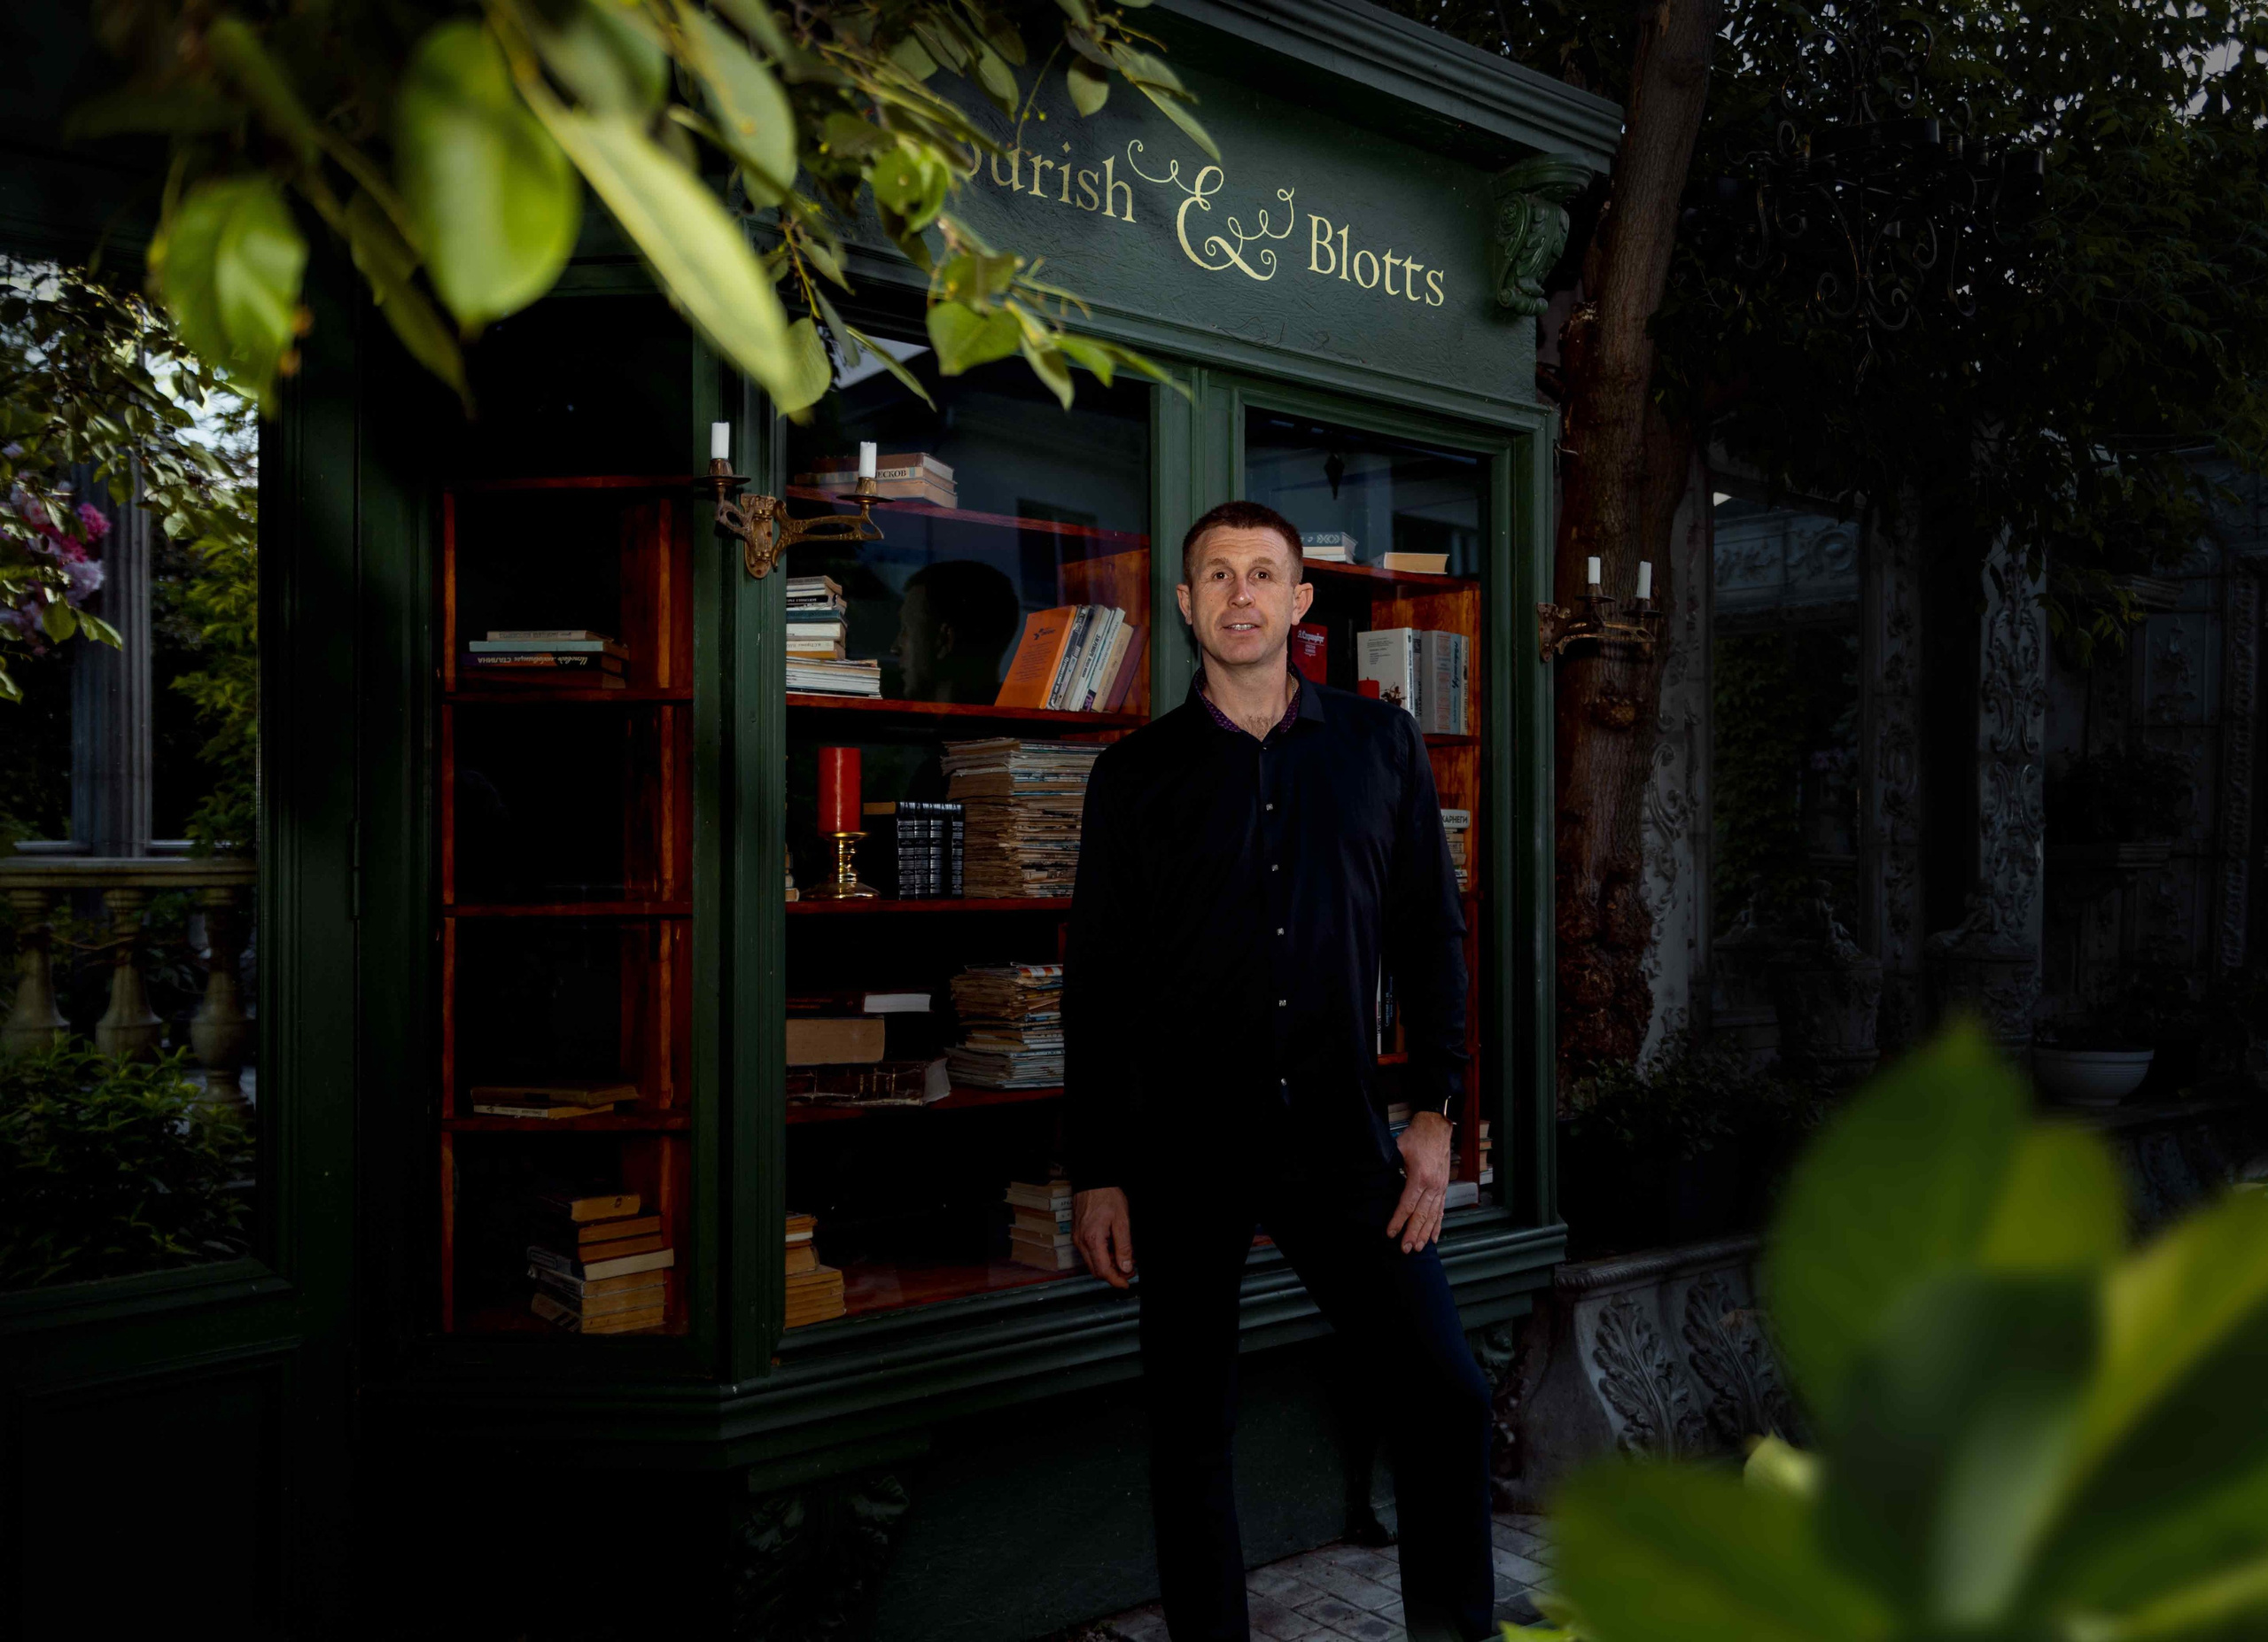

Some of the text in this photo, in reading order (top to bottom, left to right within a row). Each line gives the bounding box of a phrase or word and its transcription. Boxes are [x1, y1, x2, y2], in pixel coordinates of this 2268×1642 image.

[1128, 139, 1294, 281] &
[1308, 214, 1444, 307] Blotts
[876, 470, 906, 479] ЕСКОВ
